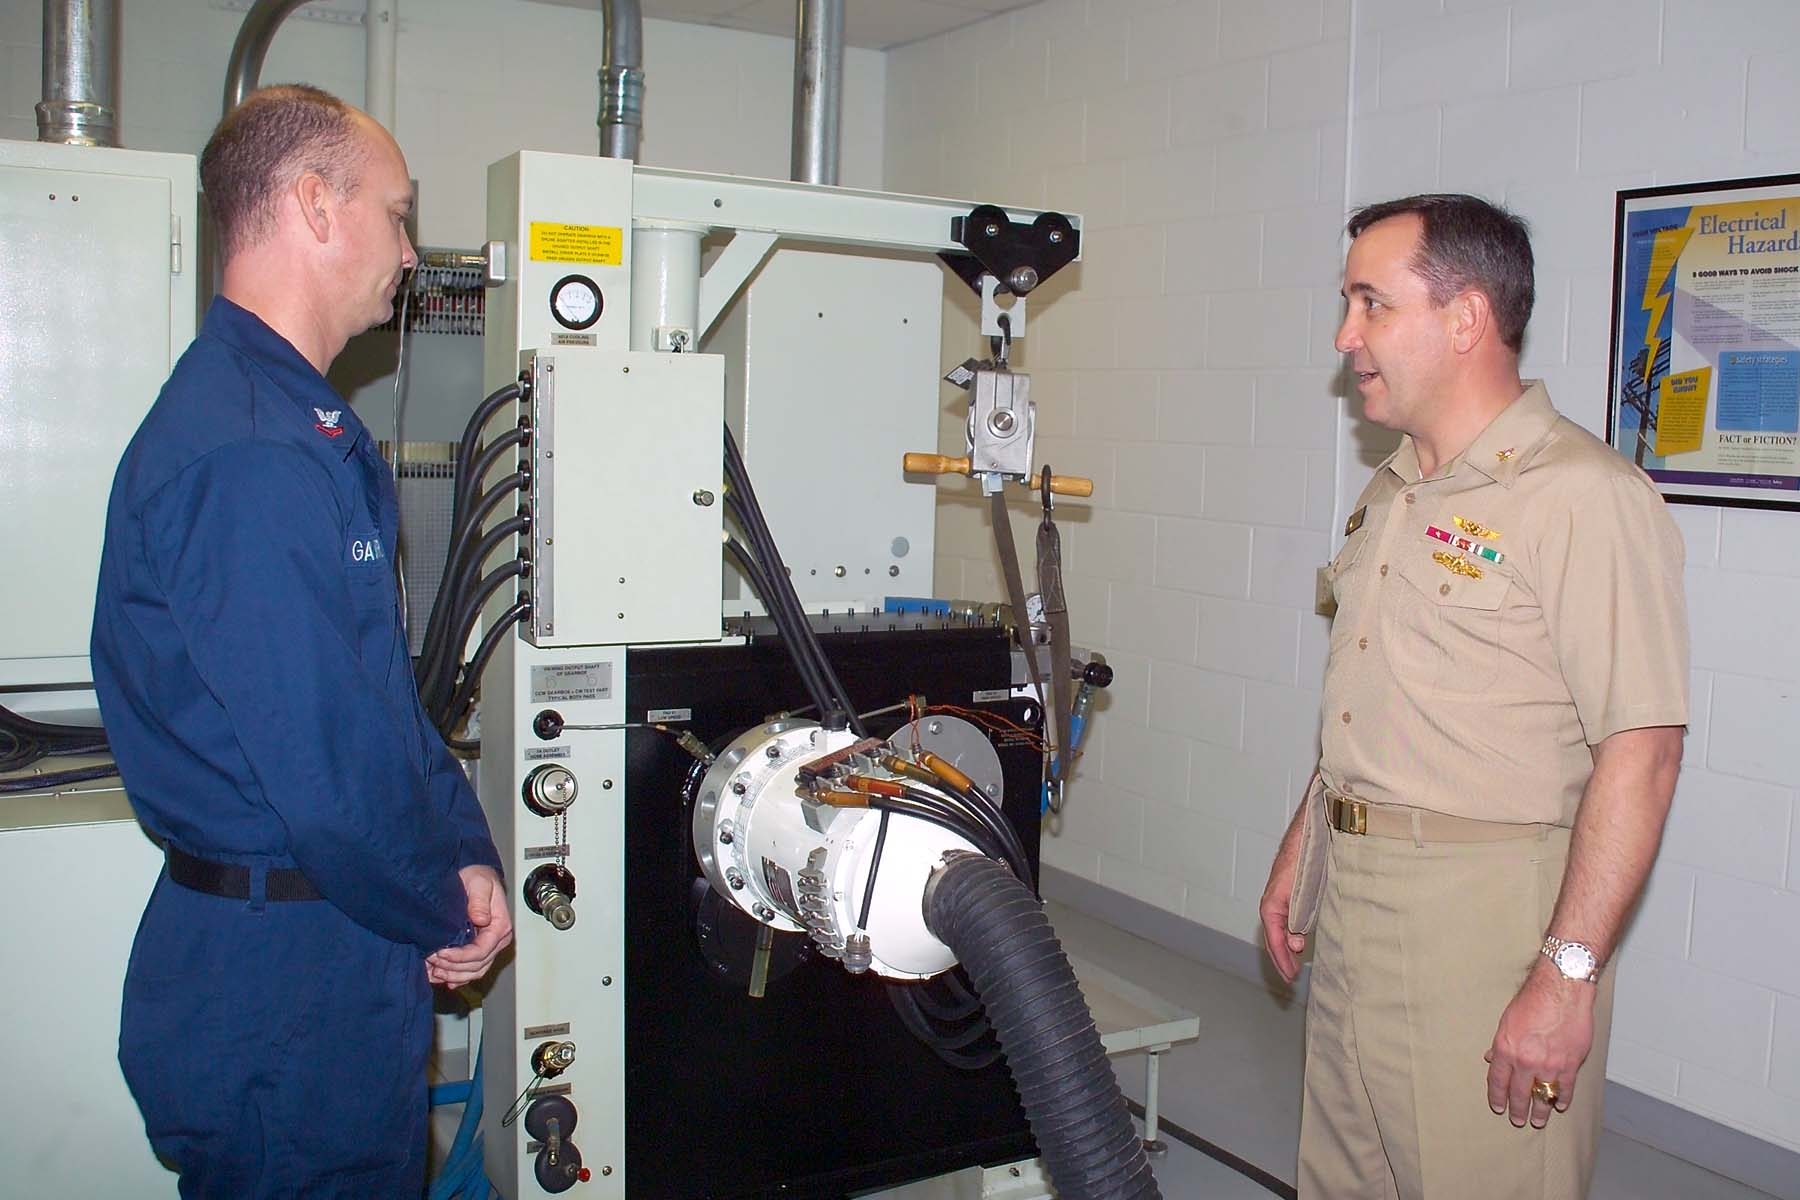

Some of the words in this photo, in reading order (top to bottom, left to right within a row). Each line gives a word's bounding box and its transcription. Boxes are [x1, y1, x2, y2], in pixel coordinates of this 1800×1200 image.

[1698, 208, 1786, 235] Electrical
[1728, 230, 1800, 255] Hazard
[1719, 435, 1742, 443] FACT
[1754, 435, 1796, 445] FICTION?
